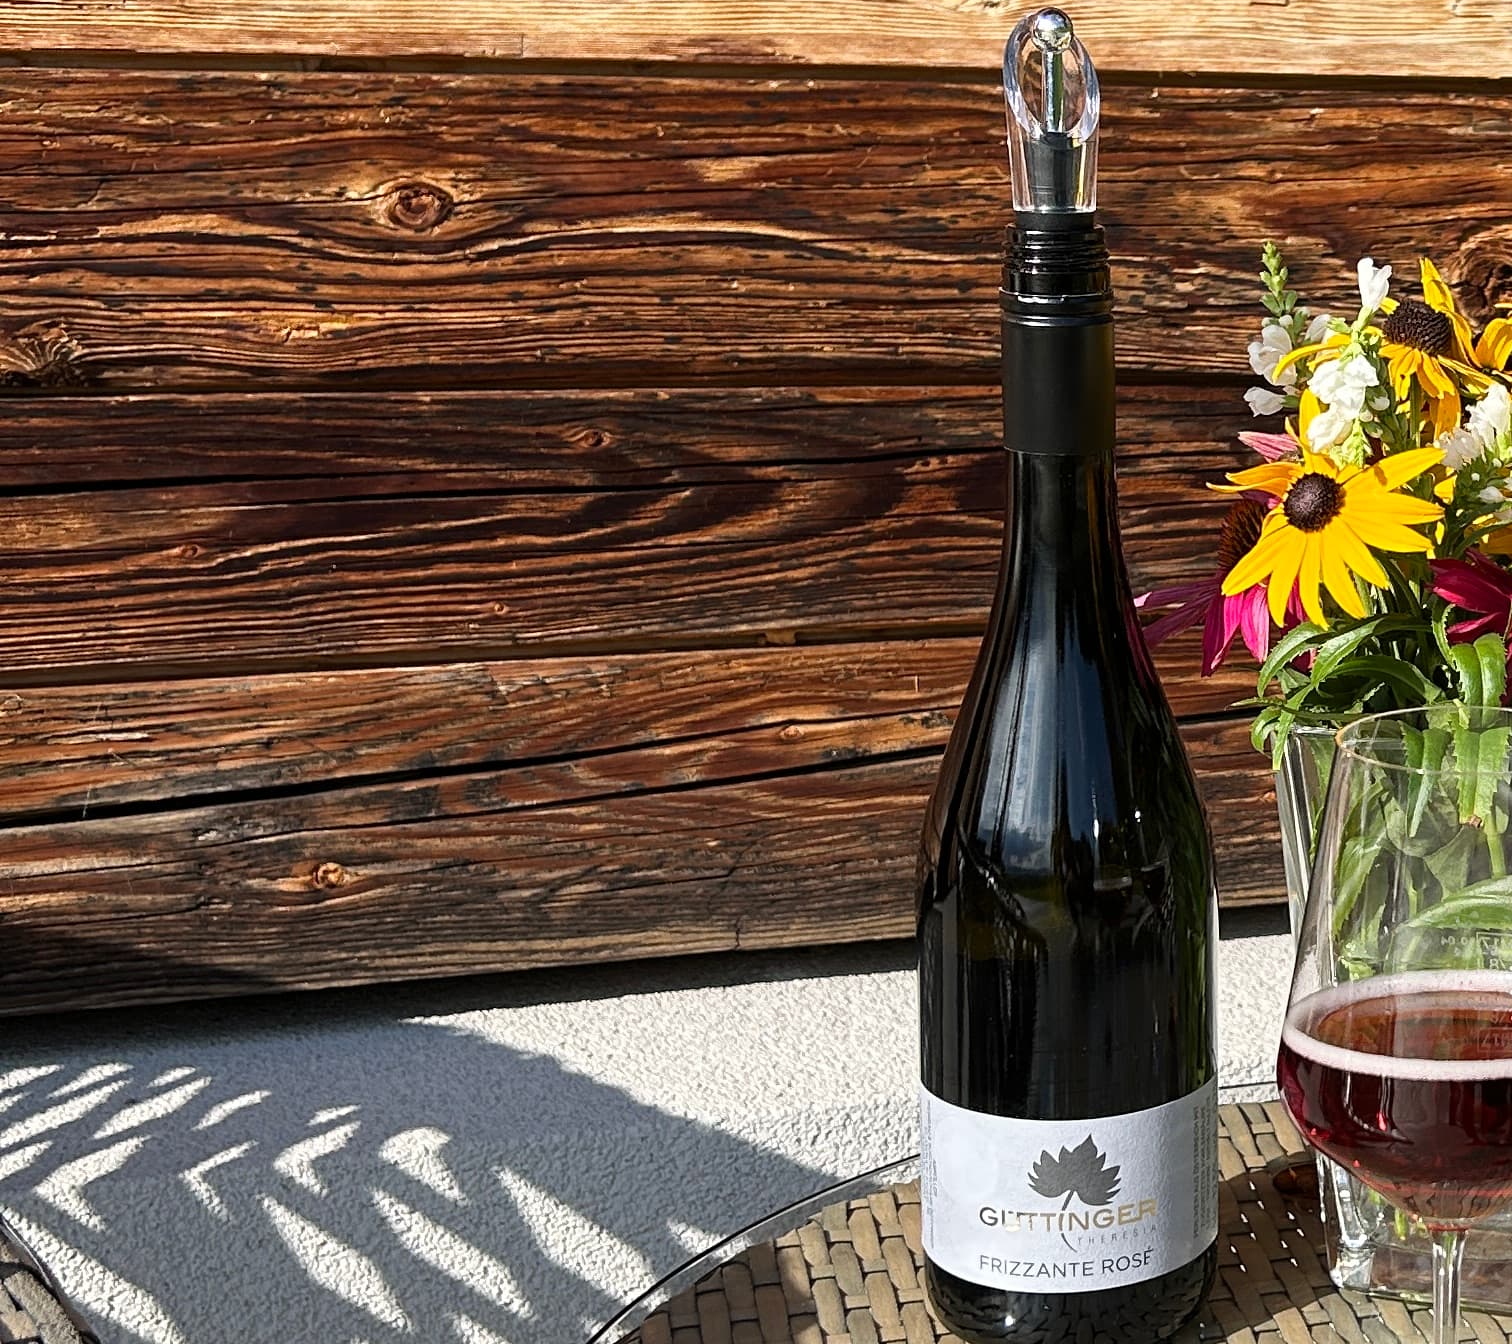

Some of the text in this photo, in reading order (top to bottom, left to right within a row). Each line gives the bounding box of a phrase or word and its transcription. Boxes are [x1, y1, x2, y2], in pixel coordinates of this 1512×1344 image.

[1077, 1224, 1158, 1246] THERESIA
[979, 1245, 1155, 1278] FRIZZANTE ROSÉ
